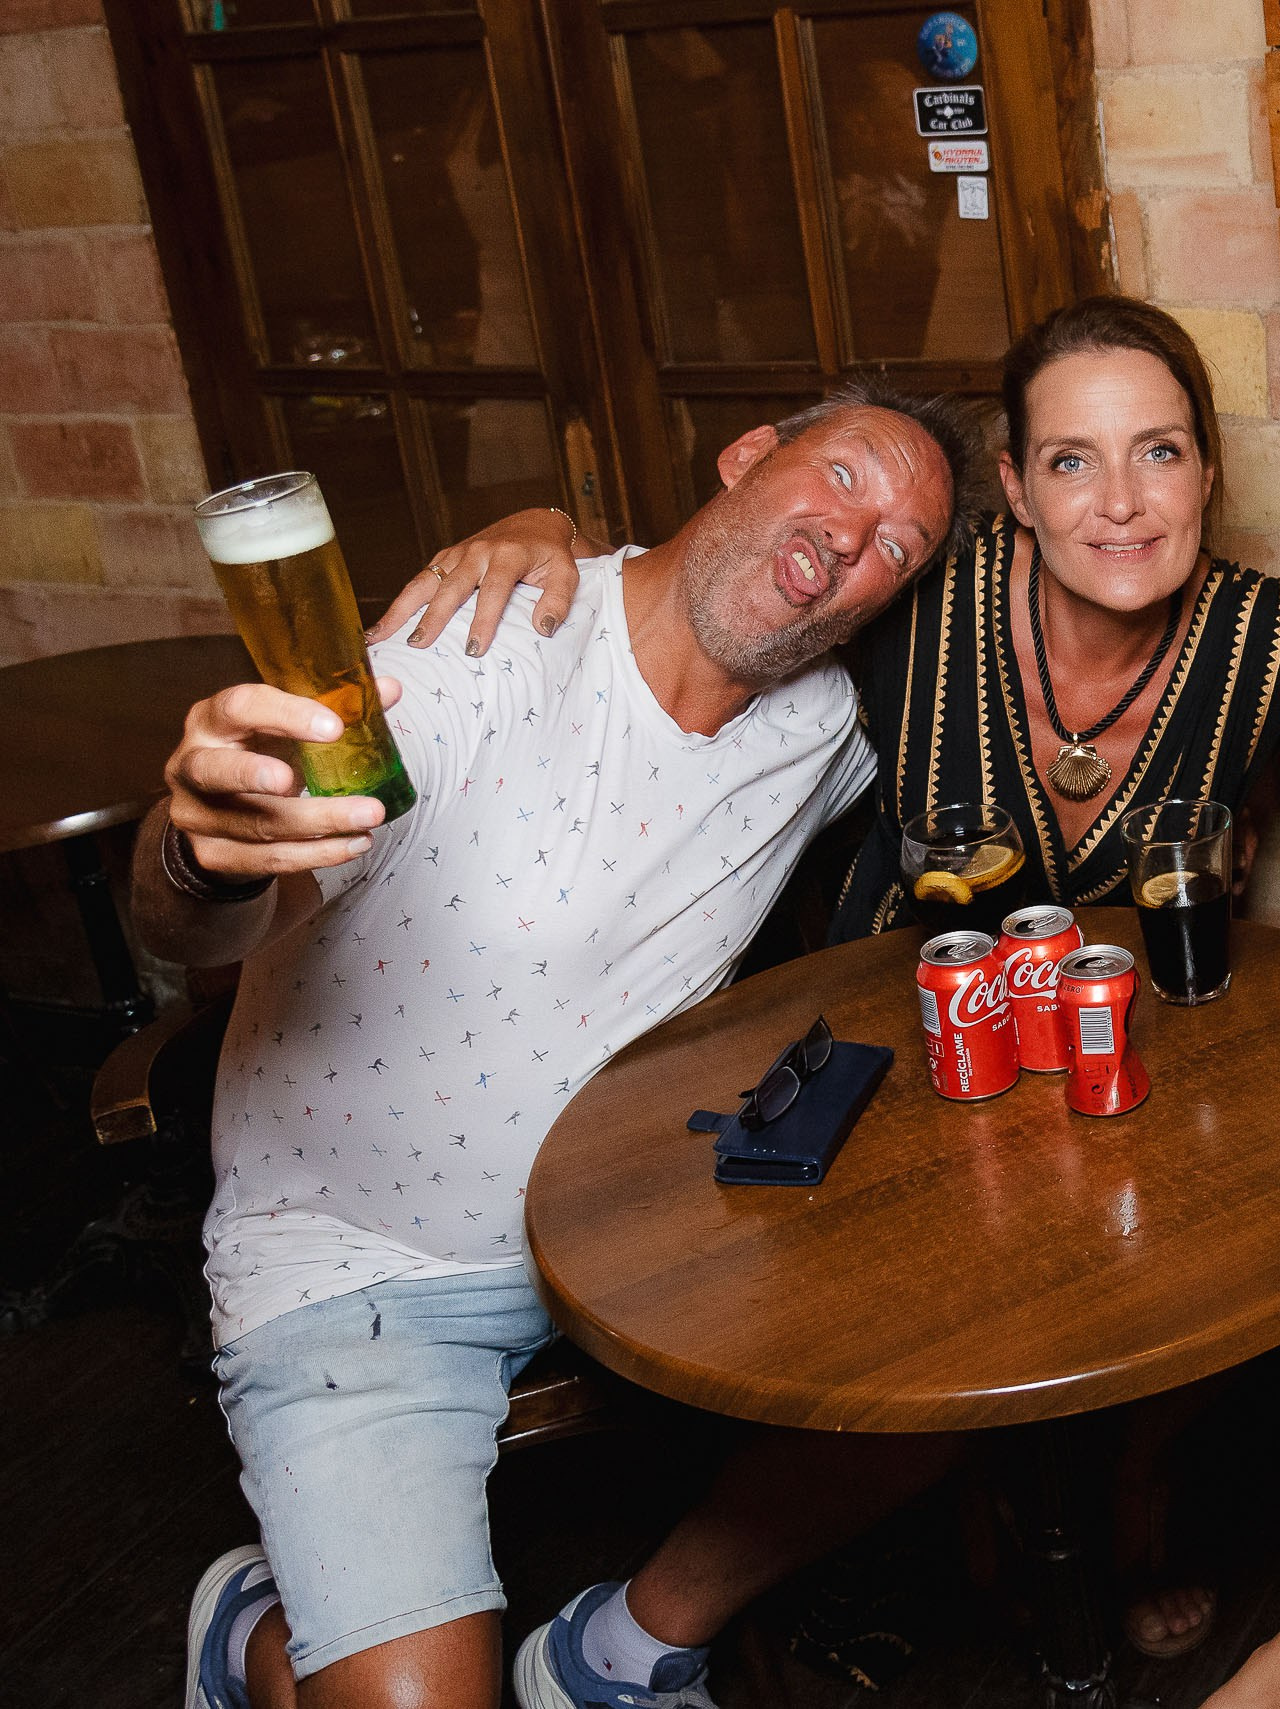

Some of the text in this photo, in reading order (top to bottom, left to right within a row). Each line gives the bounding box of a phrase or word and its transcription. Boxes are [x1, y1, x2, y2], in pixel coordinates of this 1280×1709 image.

[923, 93, 975, 107] Cardinals
[930, 117, 973, 130] Car Club
[1036, 1004, 1060, 1012] SAB
[992, 1011, 1012, 1032] SABO
[954, 1032, 970, 1092] RECÍCLAME
